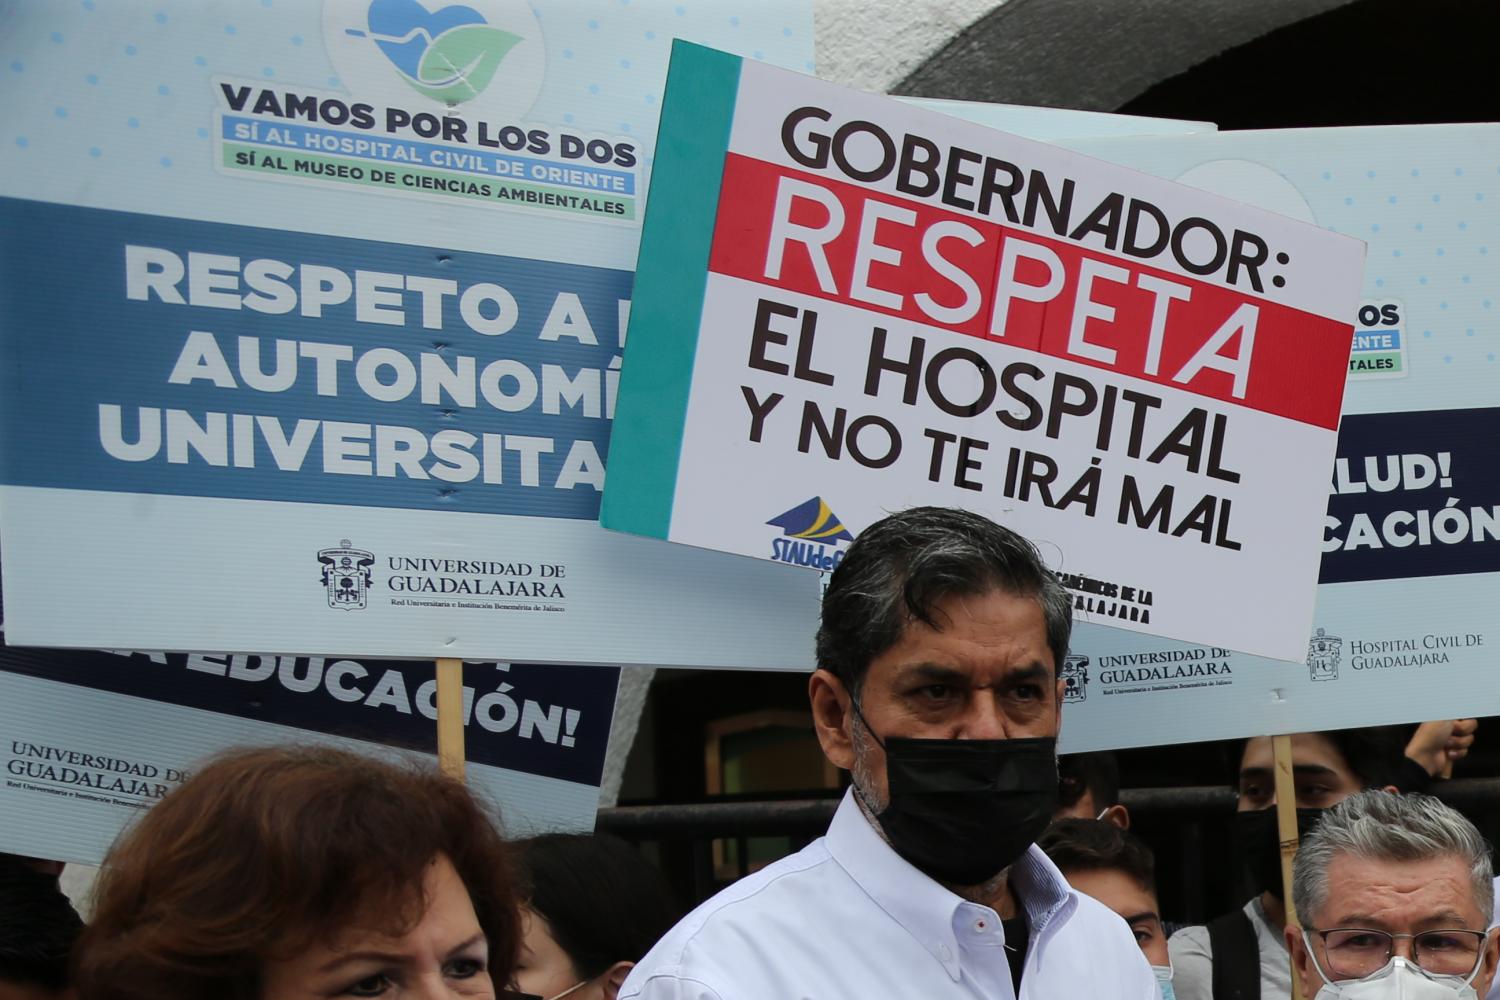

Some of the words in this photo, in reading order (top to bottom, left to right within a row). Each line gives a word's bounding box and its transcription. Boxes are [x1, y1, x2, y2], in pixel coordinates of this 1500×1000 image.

[221, 83, 376, 130] VAMOS
[386, 106, 468, 144] POR
[478, 121, 551, 156] LOS
[560, 134, 638, 168] DOS
[235, 121, 258, 140] SÍ
[266, 127, 297, 146] AL
[305, 131, 420, 163] HOSPITAL
[430, 149, 490, 173] CIVIL
[495, 158, 525, 178] DE
[531, 164, 626, 191] ORIENTE
[236, 151, 256, 167] SÍ
[261, 155, 288, 171] AL
[294, 159, 364, 181] MUSEO
[371, 169, 396, 185] DE
[402, 173, 492, 198] CIENCIAS
[497, 186, 626, 216] AMBIENTALES
[780, 105, 1292, 293] GOBERNADOR:
[124, 245, 519, 337] RESPETO
[539, 291, 600, 346] A
[763, 175, 1260, 400] RESPETA
[1358, 304, 1400, 327] OS
[748, 298, 835, 387] EL
[863, 326, 1242, 483] HOSPITAL
[98, 403, 606, 492] UNIVERSITA
[740, 385, 785, 443] Y
[798, 405, 902, 470] NO
[923, 427, 989, 494] TE
[1003, 446, 1102, 517] IRÁ
[1118, 474, 1243, 552] MAL
[1331, 451, 1453, 495] LUD!
[388, 556, 533, 577] UNIVERSIDAD
[540, 564, 566, 578] DE
[388, 575, 566, 599] GUADALAJARA
[391, 598, 406, 607] Red
[1137, 589, 1153, 606] LA
[1099, 648, 1206, 669] UNIVERSIDAD
[1211, 647, 1232, 660] DE
[1465, 634, 1484, 646] DE
[1099, 661, 1232, 685] GUADALAJARA
[11, 740, 158, 779] UNIVERSIDAD
[165, 768, 192, 784] DE
